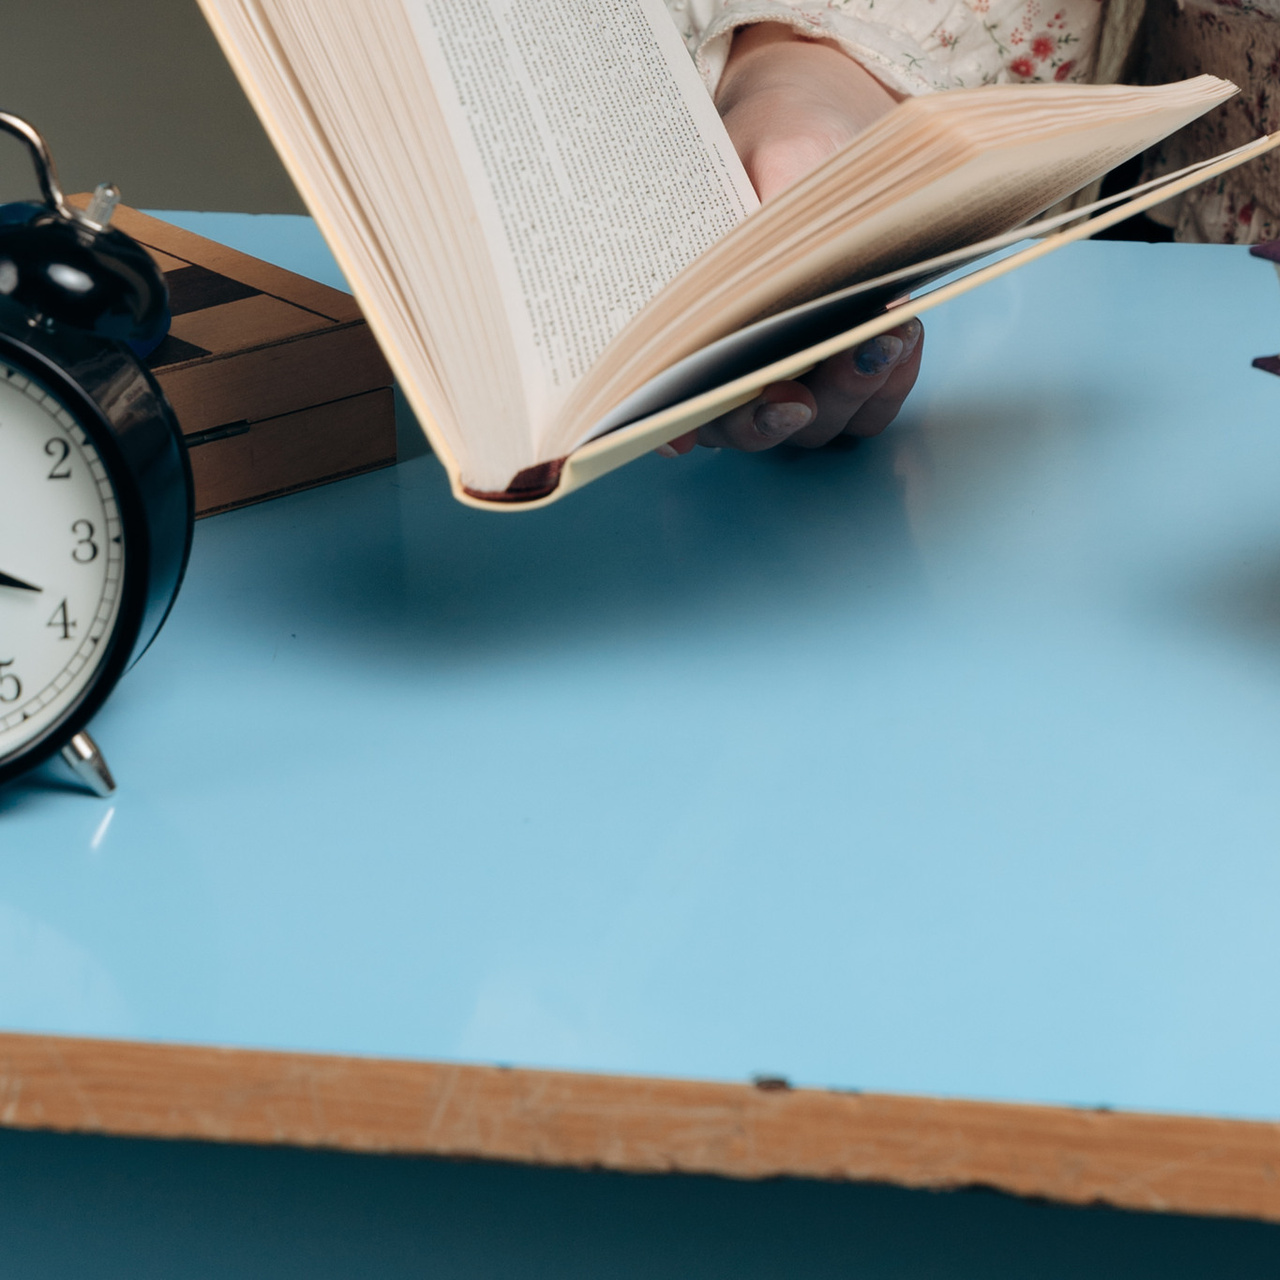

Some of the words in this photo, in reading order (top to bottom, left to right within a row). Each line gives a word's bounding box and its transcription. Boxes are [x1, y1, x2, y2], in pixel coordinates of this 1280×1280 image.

[45, 436, 72, 480] 2
[71, 519, 99, 565] 3
[46, 597, 78, 640] 4
[0, 657, 22, 703] 5
